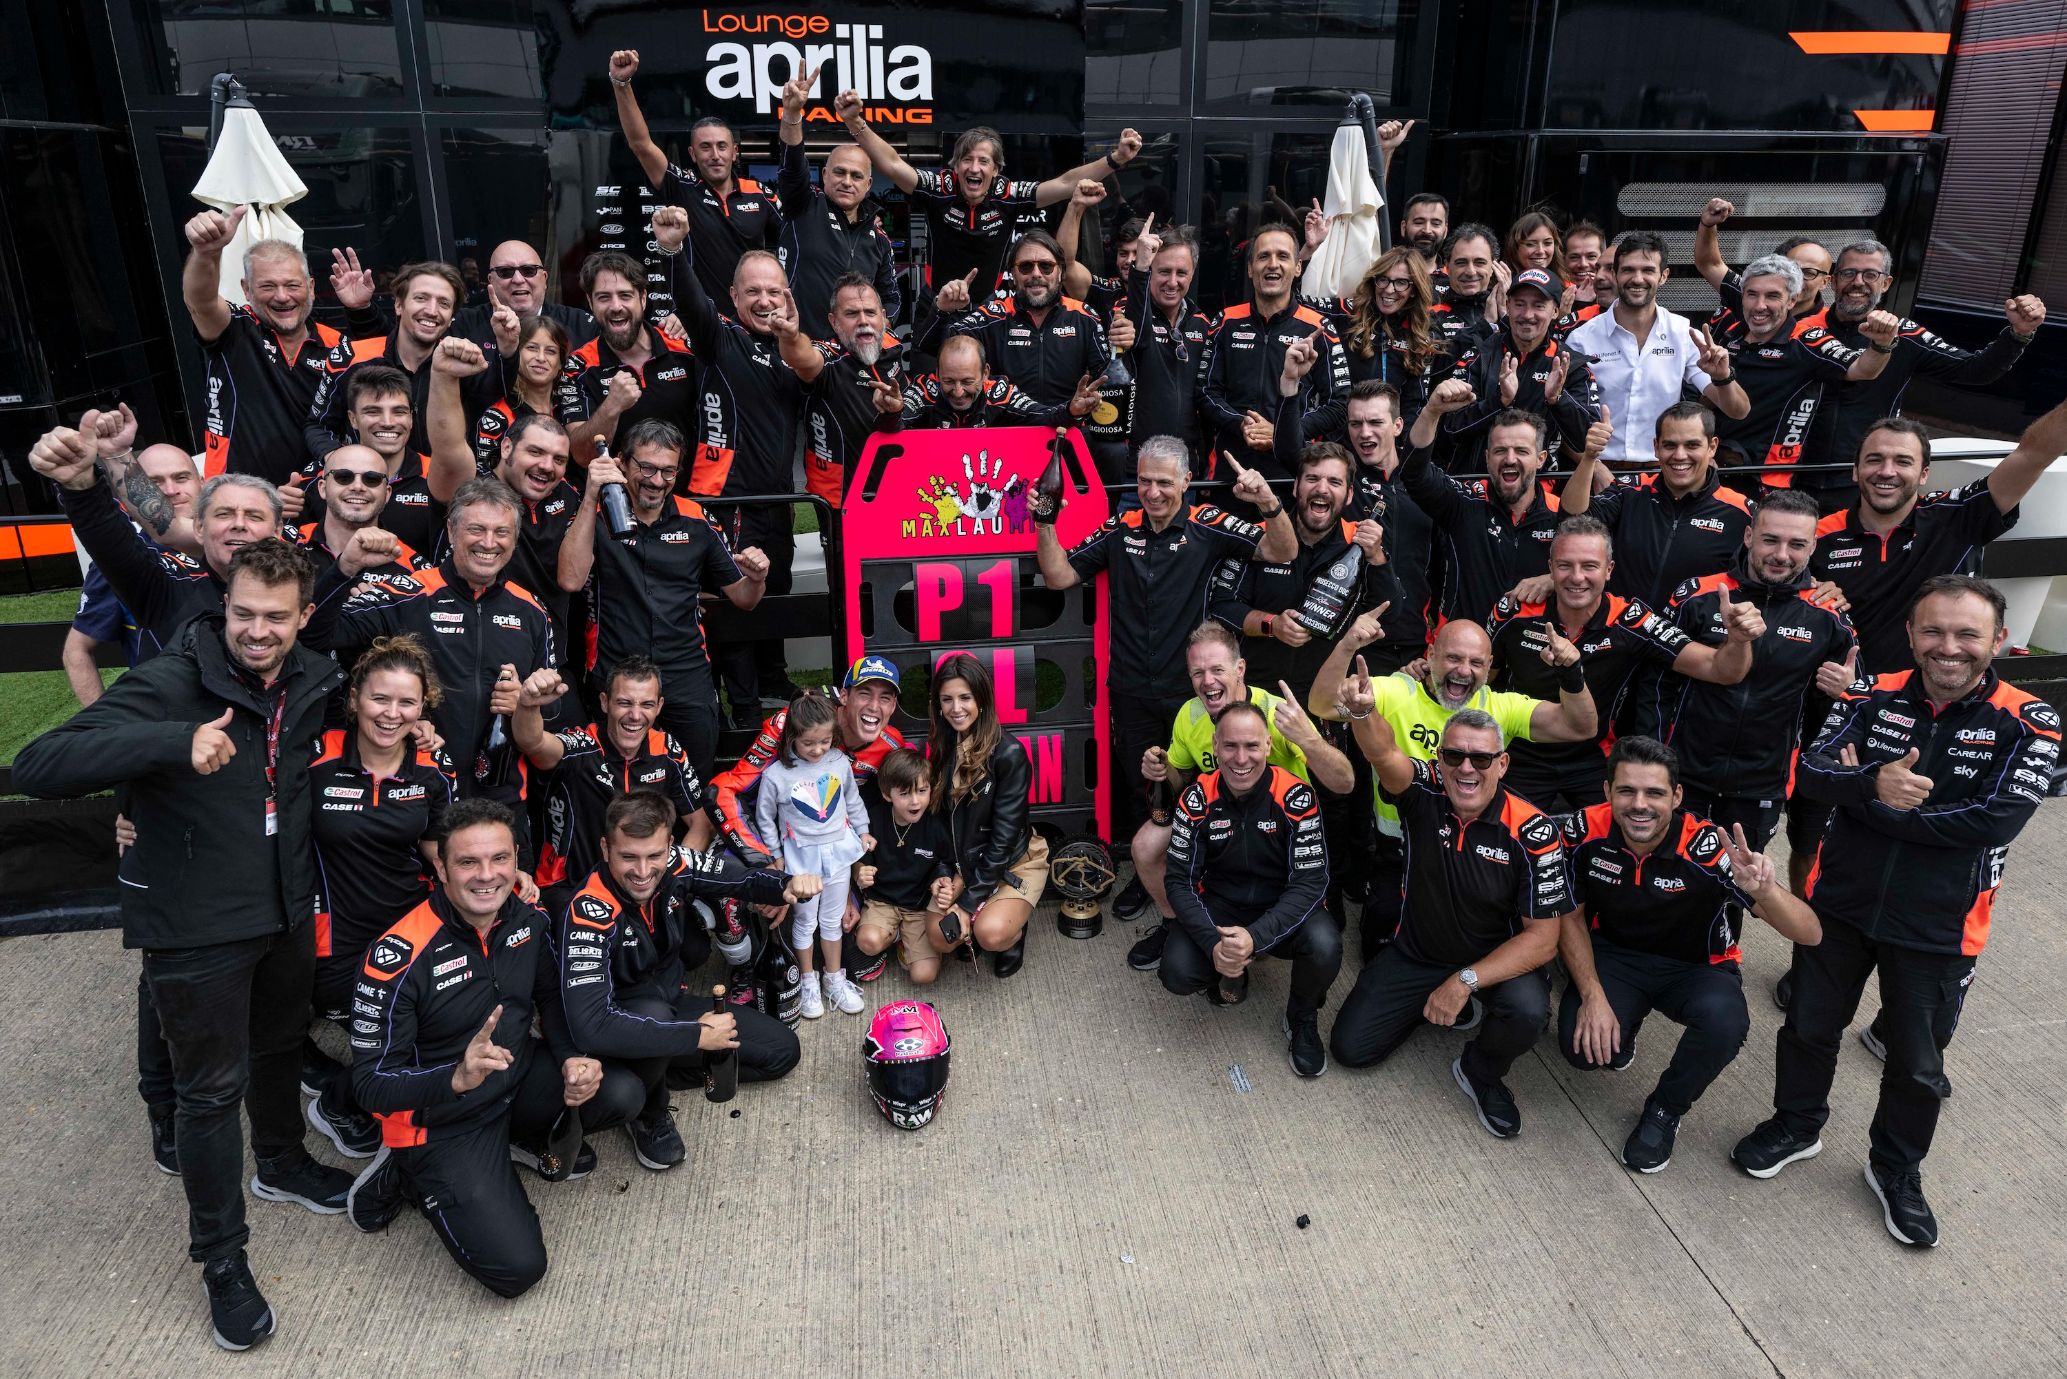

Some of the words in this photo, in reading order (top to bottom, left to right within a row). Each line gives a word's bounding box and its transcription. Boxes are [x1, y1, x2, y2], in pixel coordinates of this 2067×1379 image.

[703, 9, 830, 38] Lounge
[705, 23, 934, 114] aprilia
[777, 106, 933, 124] AING
[1052, 326, 1076, 336] aprilia
[1652, 346, 1675, 356] aprilia
[657, 366, 687, 380] aprilia
[206, 376, 224, 450] aprilia
[704, 392, 728, 462] aprilia
[1778, 398, 1816, 458] aprilia
[396, 492, 428, 504] aprilia
[1690, 517, 1724, 532] aprilia
[660, 530, 689, 544] aprilia
[1828, 562, 1852, 570] CASE
[438, 613, 462, 622] Castrol
[1303, 600, 1336, 620] WINNER
[492, 614, 521, 627] aprilia
[1776, 626, 1812, 640] aprilia
[1886, 713, 1914, 728] Castrol
[1872, 724, 1901, 740] CASE
[1955, 728, 1996, 742] aprilia
[1948, 748, 1993, 761] CAREAR
[640, 769, 666, 783] aprilia
[1953, 764, 1978, 779] sky
[334, 788, 360, 797] Castrol
[388, 784, 426, 800] aprilia
[322, 803, 354, 811] CASE
[730, 832, 744, 848] racer
[1294, 844, 1322, 856] BS
[1476, 844, 1510, 862] aprilia
[1599, 860, 1620, 872] Castrol
[1588, 870, 1612, 883] CASE
[506, 926, 531, 948] aprilia
[570, 931, 596, 941] CAME
[440, 957, 466, 974] Castrol
[356, 982, 376, 998] CAME
[436, 974, 463, 991] CASE
[892, 1108, 933, 1126] RAW
